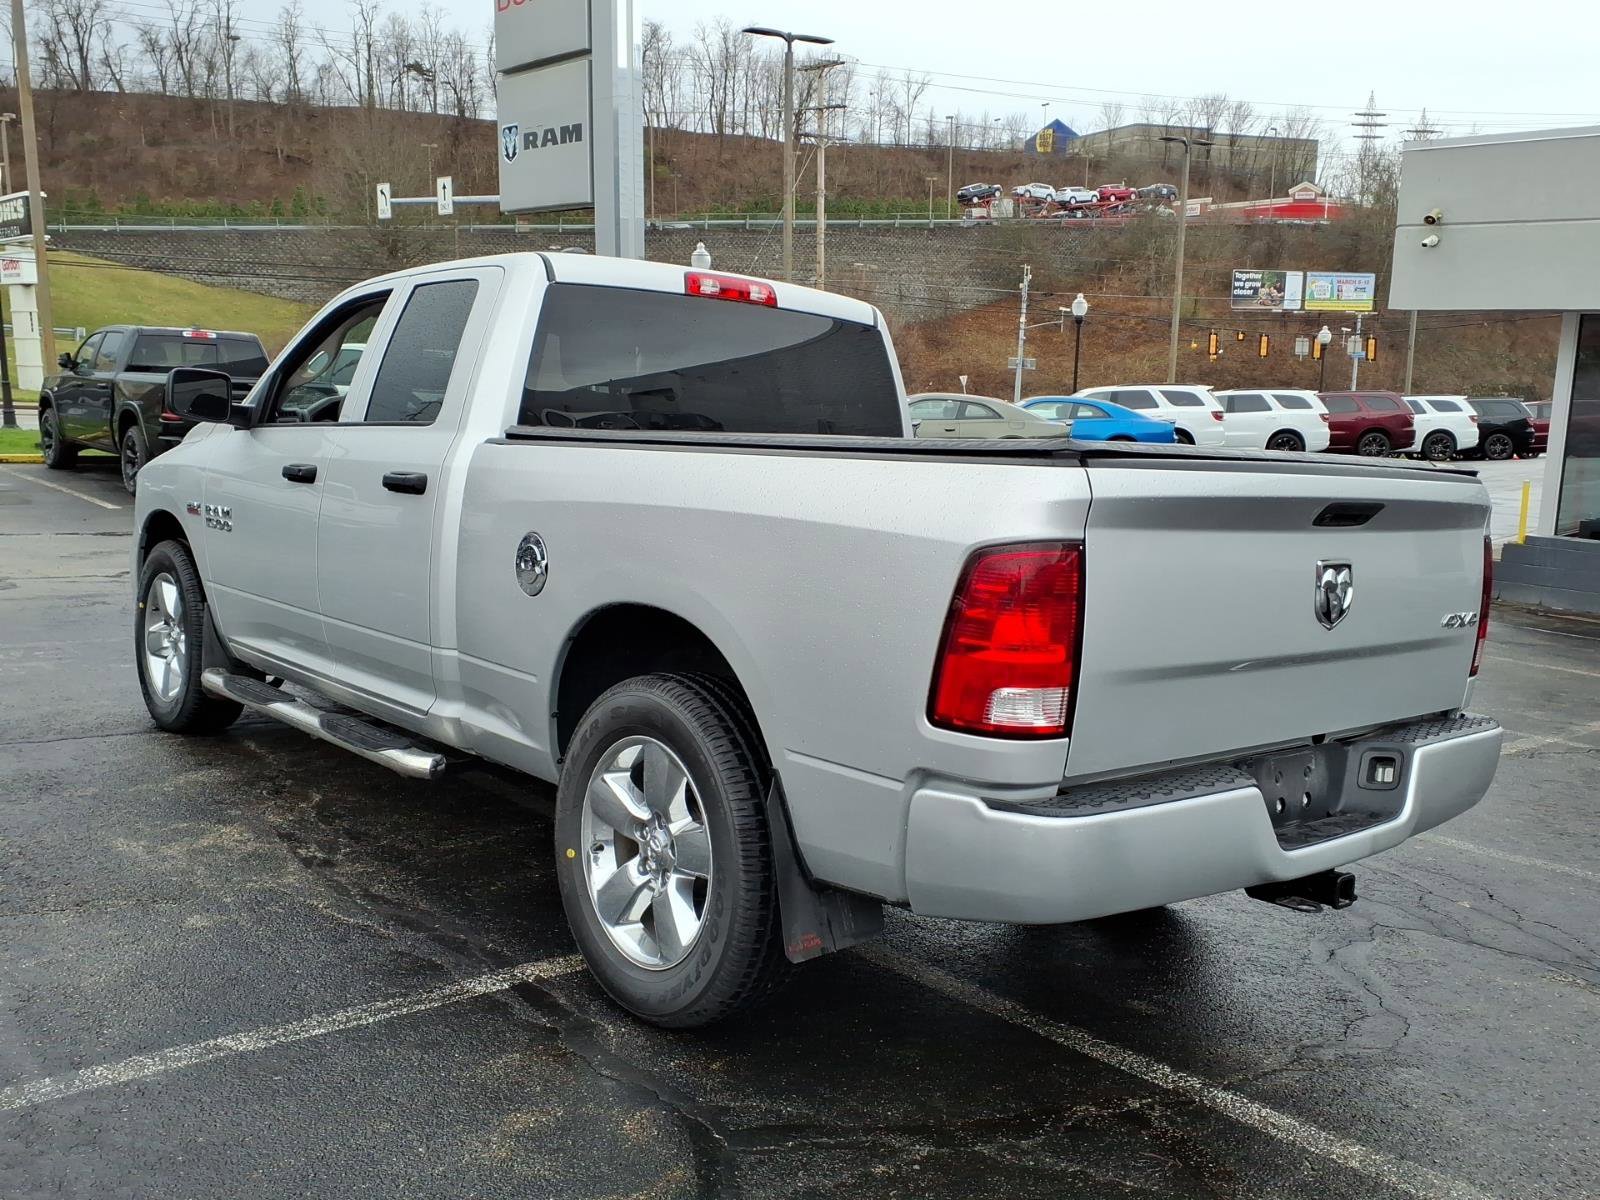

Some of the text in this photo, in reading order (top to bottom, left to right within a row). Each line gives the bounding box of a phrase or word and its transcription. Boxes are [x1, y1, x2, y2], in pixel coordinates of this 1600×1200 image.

[523, 122, 583, 151] RAM
[1234, 272, 1263, 281] Together
[205, 504, 233, 519] RAM
